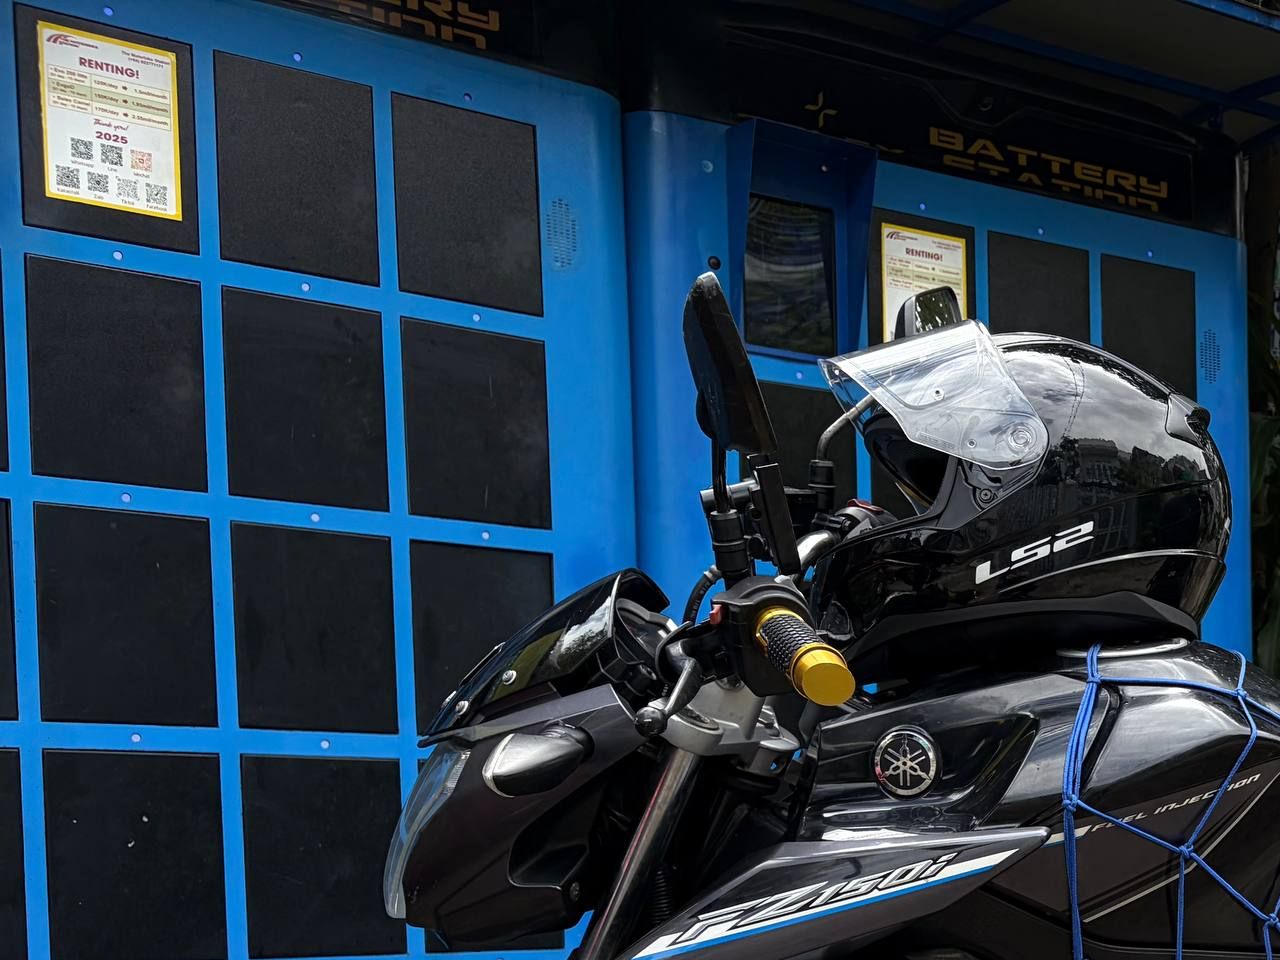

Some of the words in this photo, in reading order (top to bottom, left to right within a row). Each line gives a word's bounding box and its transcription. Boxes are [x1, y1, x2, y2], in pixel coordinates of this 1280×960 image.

[78, 56, 140, 79] RENTING!
[95, 131, 129, 144] 2025
[928, 126, 1168, 199] BATTERY
[905, 246, 943, 262] RENTING!
[975, 520, 1095, 585] LS2
[1153, 773, 1262, 816] INJECION
[666, 850, 960, 946] FZ150i
